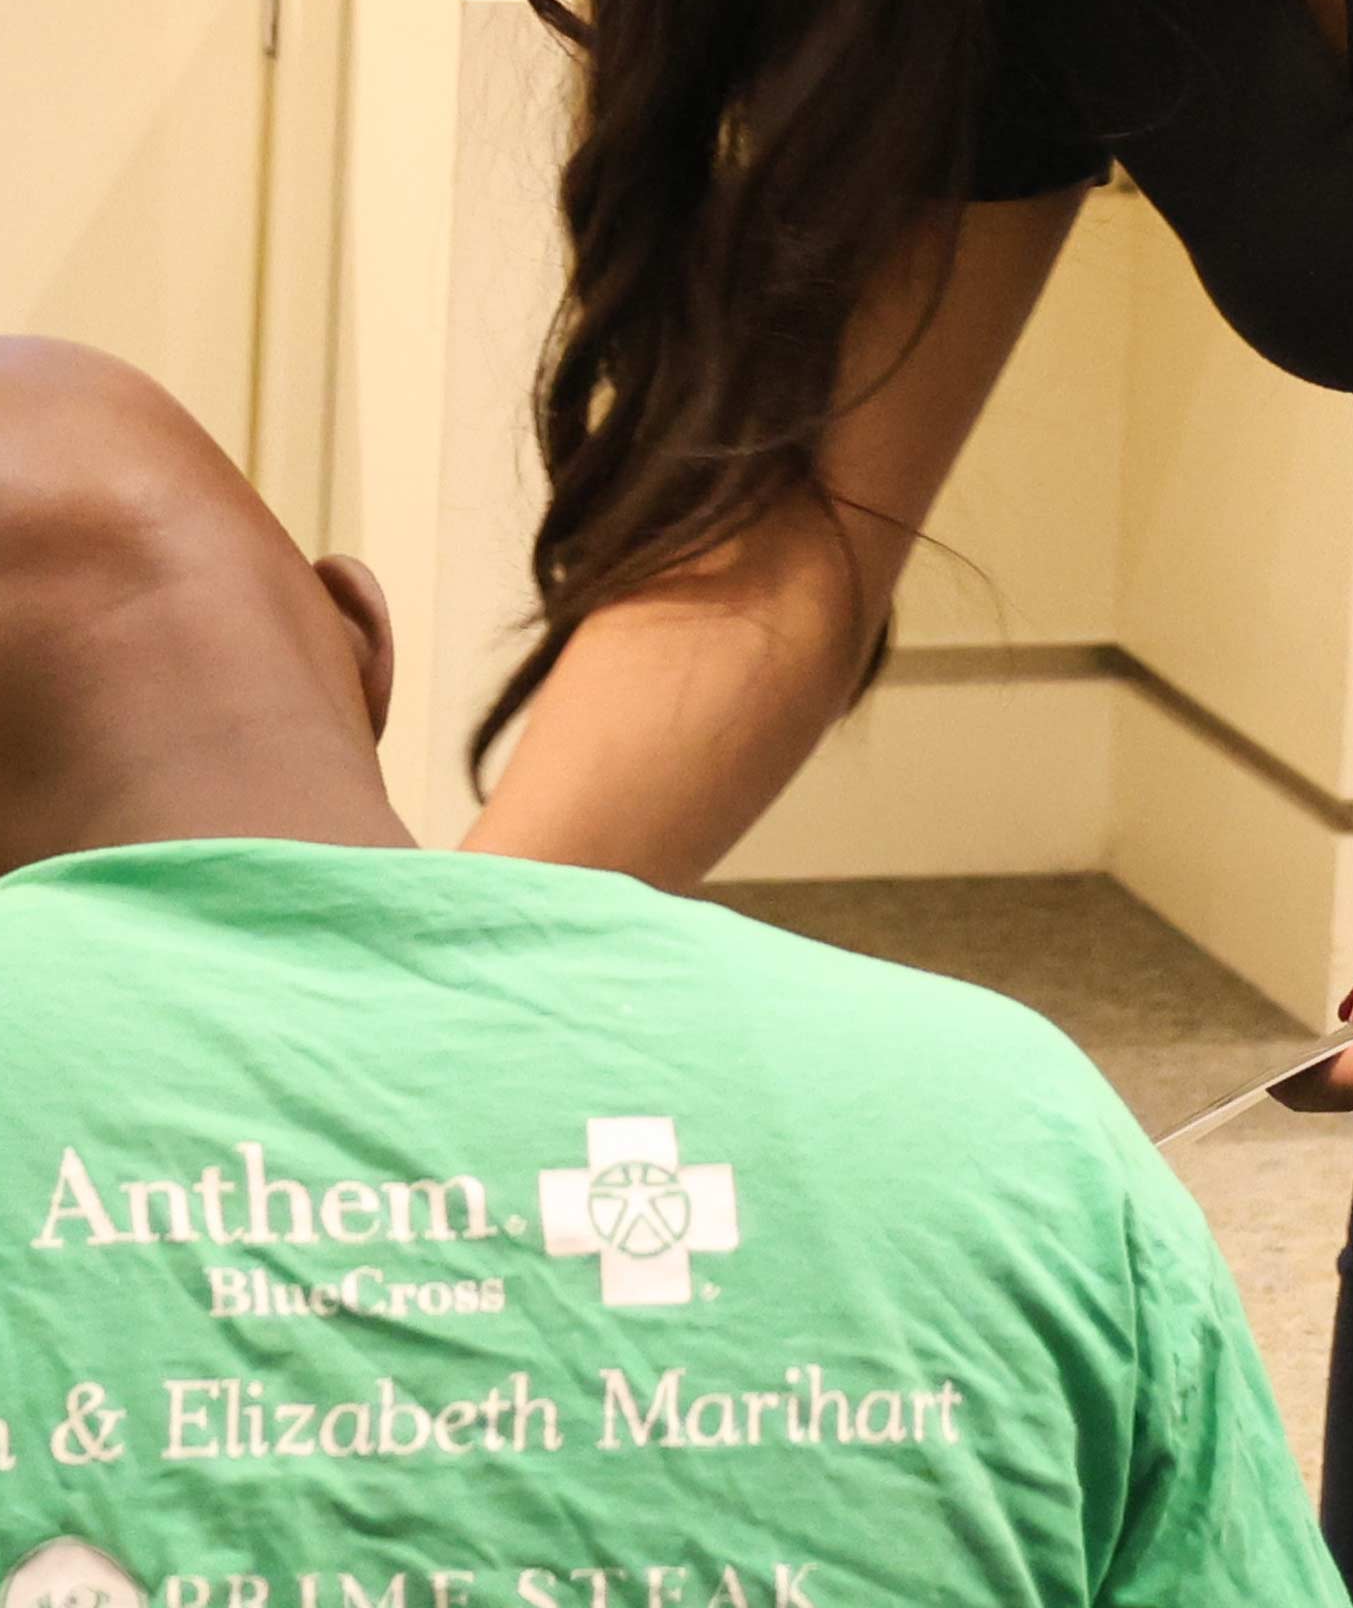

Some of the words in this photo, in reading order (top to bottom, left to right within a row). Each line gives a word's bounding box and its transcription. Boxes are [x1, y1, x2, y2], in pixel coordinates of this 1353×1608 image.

[205, 1264, 506, 1318] BlueCross
[50, 1381, 128, 1467] &
[161, 1371, 564, 1460] Elizabeth
[595, 1363, 963, 1450] Marihart
[164, 1569, 477, 1608] PRIME
[515, 1561, 822, 1608] STEAK
